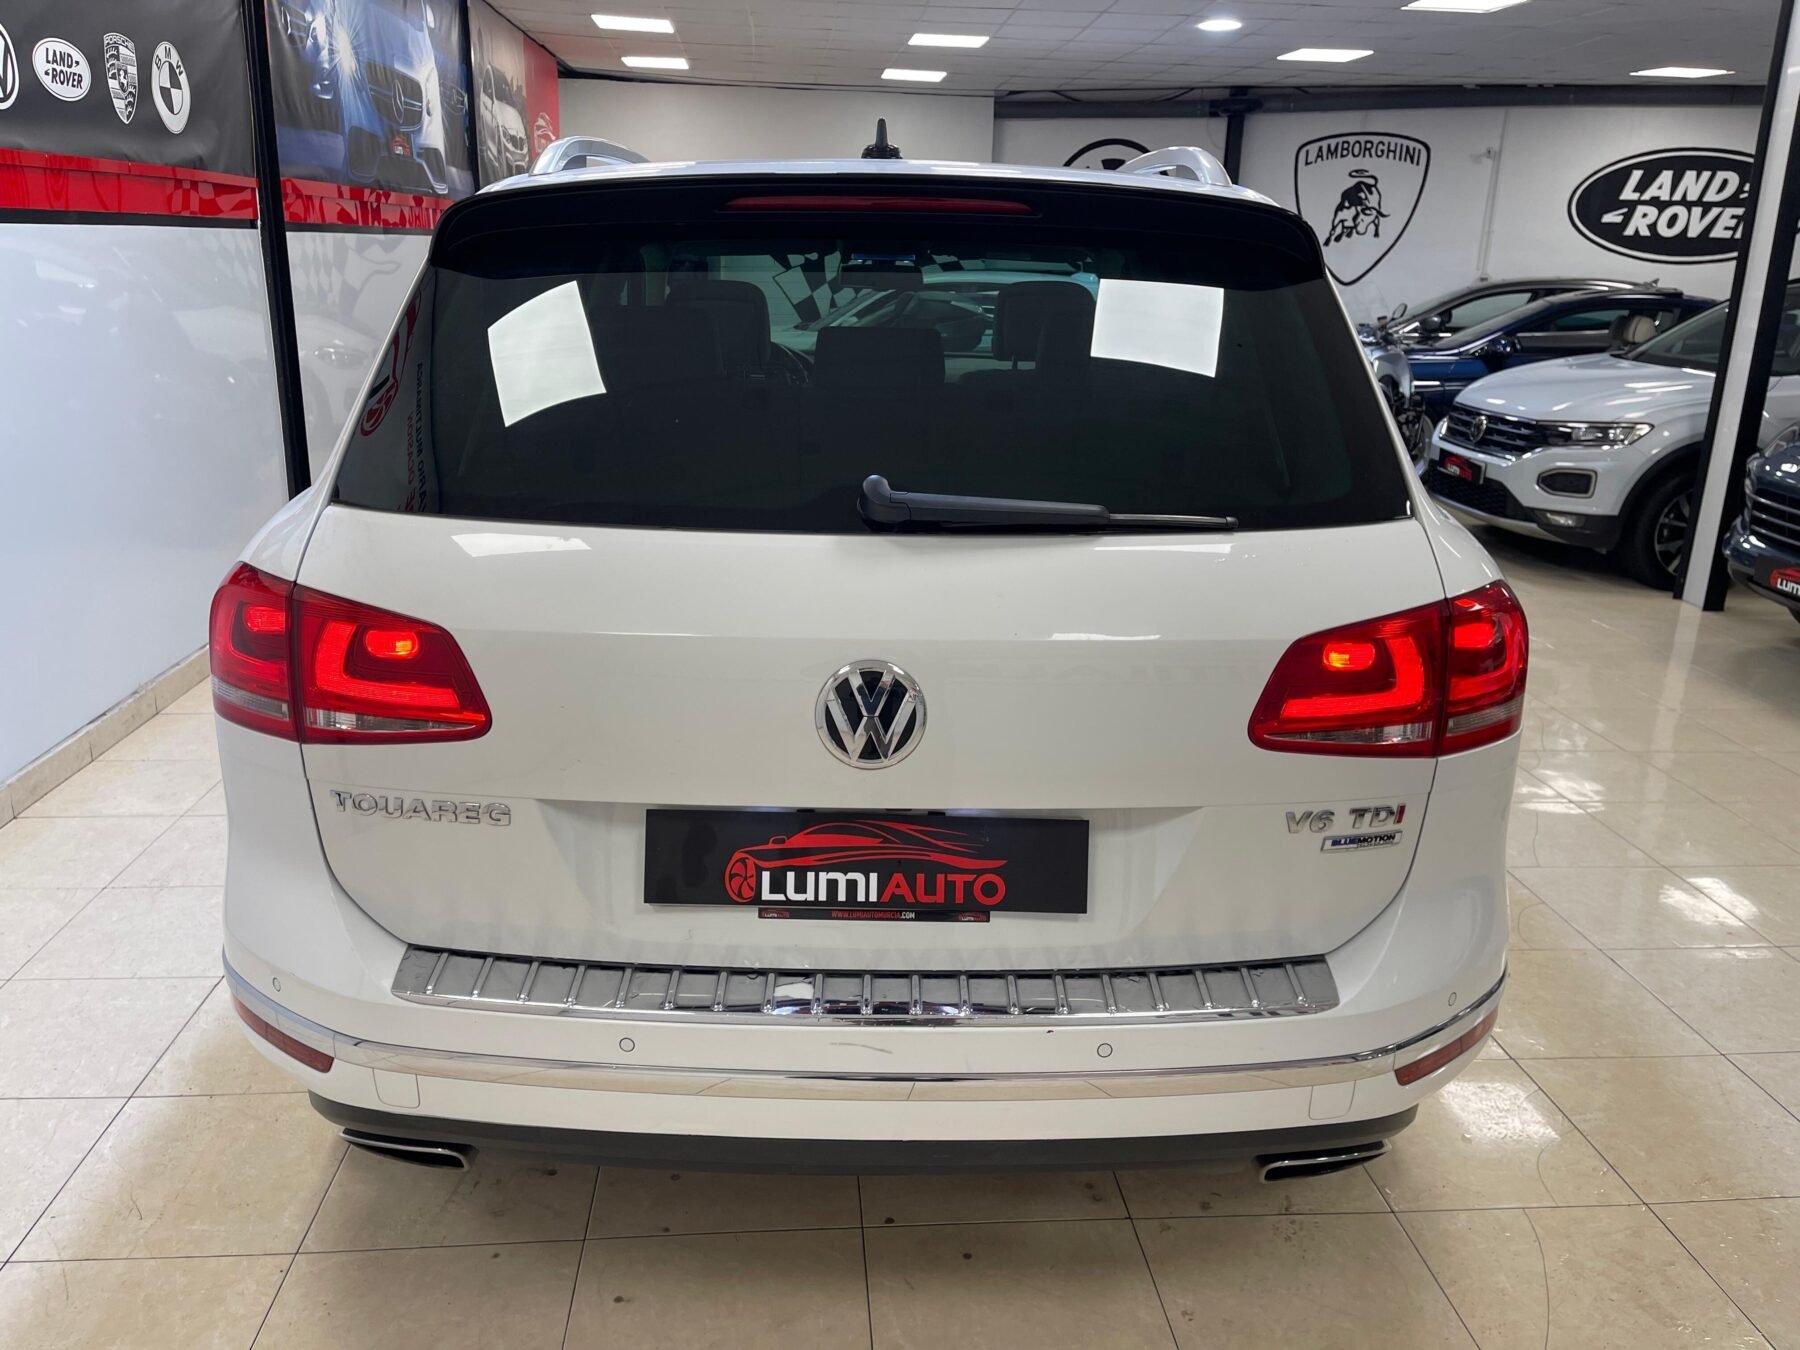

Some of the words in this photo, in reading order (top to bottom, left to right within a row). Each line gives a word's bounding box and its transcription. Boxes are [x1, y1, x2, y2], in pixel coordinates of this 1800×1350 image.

[45, 47, 74, 69] LAND
[154, 46, 184, 77] BMW
[51, 68, 83, 90] ROVER
[1304, 140, 1422, 167] LAMBORGHINI
[1618, 169, 1740, 203] LAND
[329, 789, 512, 827] TOUAREG
[1285, 809, 1336, 834] V6
[1349, 804, 1407, 829] TDI
[831, 910, 916, 920] WWW.LUMIAUTOMURCIA.COM
